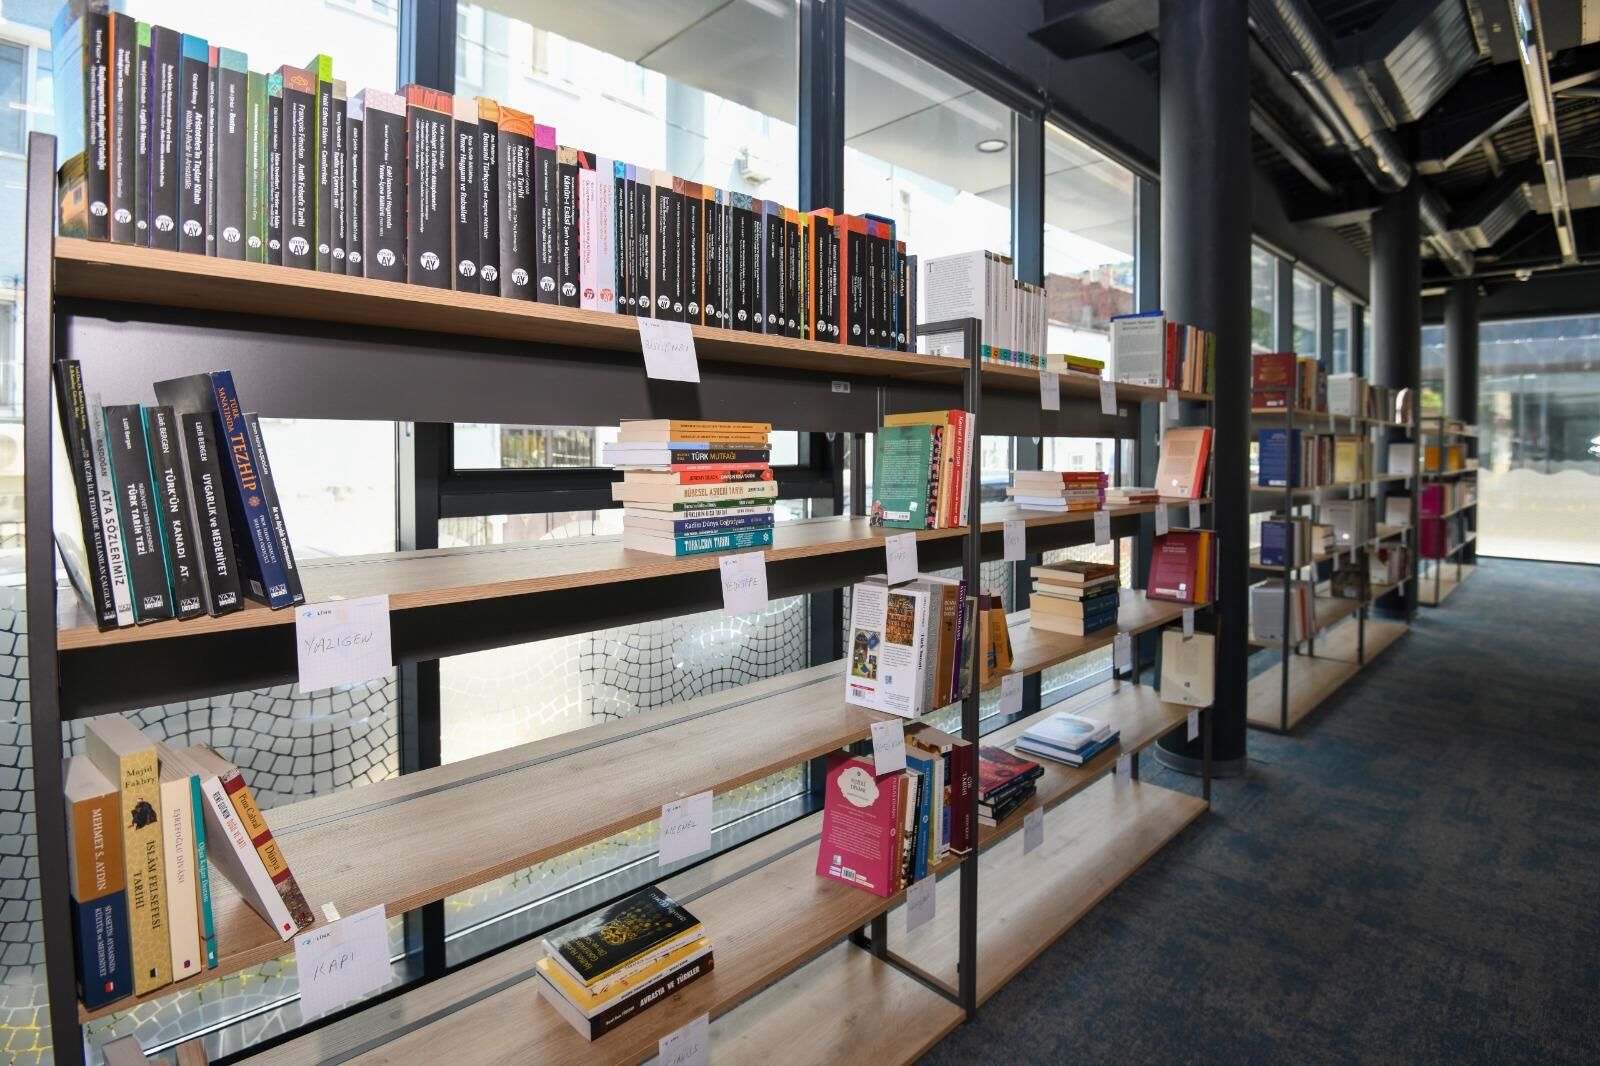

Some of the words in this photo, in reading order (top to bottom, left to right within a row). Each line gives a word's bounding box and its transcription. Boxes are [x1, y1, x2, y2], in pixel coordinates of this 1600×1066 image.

[228, 112, 236, 134] Bostan
[296, 104, 306, 133] François
[194, 112, 203, 159] Aristoteles'in
[298, 133, 306, 159] Fénelon
[460, 134, 468, 152] Ömer
[97, 139, 106, 170] Ortadoğu
[459, 154, 467, 182] Hayyam
[192, 160, 202, 182] Taşlar
[298, 163, 306, 182] Antik
[482, 162, 490, 191] Türkçesi
[193, 183, 202, 204] Kitabı
[460, 183, 466, 191] ve
[517, 177, 525, 199] Tarihi
[297, 207, 305, 227] Tarihi
[460, 192, 468, 224] Rubaileri
[218, 387, 235, 433] SANATINDA
[229, 397, 240, 420] TÜRK
[124, 430, 132, 449] Bergen
[160, 427, 170, 454] BERGEN
[198, 437, 207, 462] BERGEN
[230, 432, 257, 491] TEZHİP
[691, 452, 709, 461] TÜRK
[100, 489, 113, 516] AT'A
[127, 484, 139, 507] TÜRK
[202, 473, 217, 516] UYGARLIK
[131, 508, 143, 535] TARİH
[164, 468, 179, 513] TÜRK'ÜN
[173, 520, 185, 559] KANADI
[179, 565, 190, 578] AT
[209, 516, 218, 527] ve
[702, 520, 718, 529] Dünya
[94, 532, 105, 574] KULLANILAN
[105, 518, 125, 586] SÖZLERİMİZ
[136, 535, 147, 556] TEZİ
[211, 528, 228, 577] MEDENİYET
[99, 576, 111, 609] ÇALGILAR
[91, 808, 103, 851] MEHMET
[173, 808, 185, 854] EŞREFOĞLU
[246, 808, 262, 830] Cabral
[95, 852, 104, 860] S.
[146, 840, 159, 873] İSLÂM
[264, 844, 281, 870] Dünya
[95, 862, 107, 891] AYDIN
[133, 870, 145, 910] TARİHİ
[148, 875, 161, 930] FELSEFESİ
[313, 952, 354, 981] KAPI
[640, 986, 665, 1007] AVRASYA
[676, 966, 700, 984] TÜRKLER
